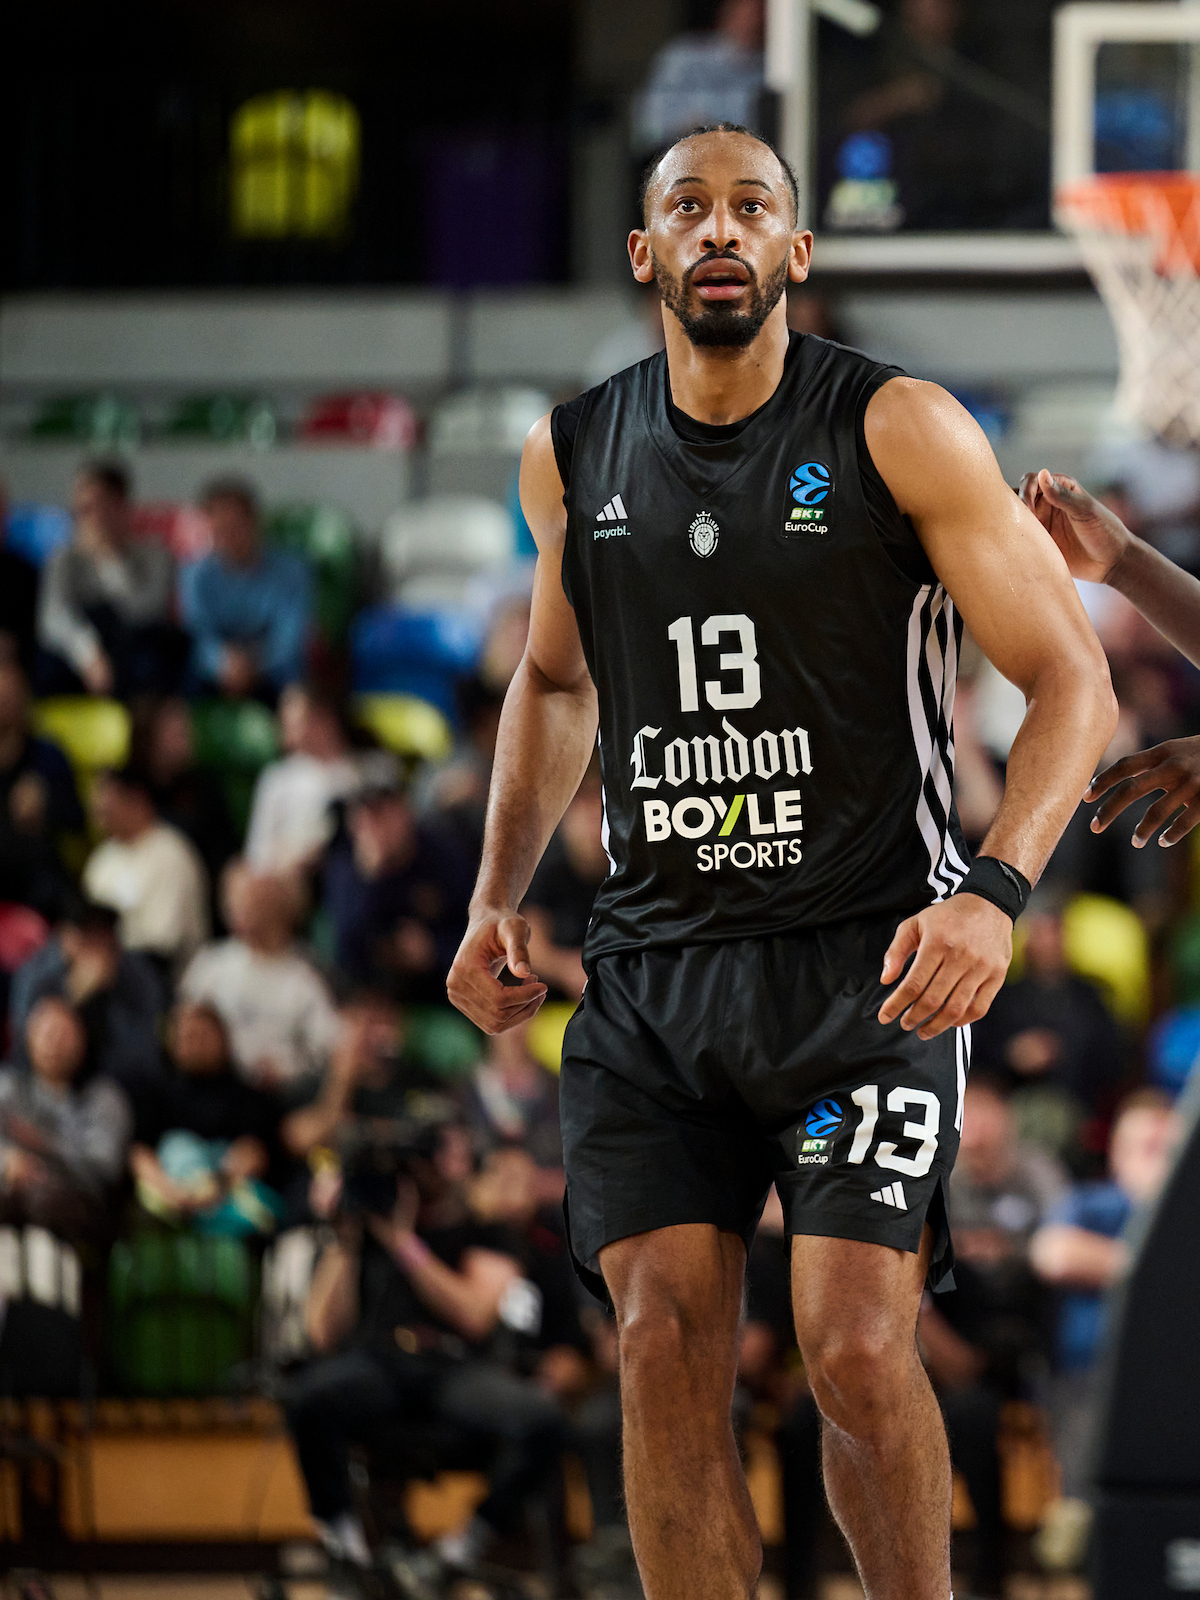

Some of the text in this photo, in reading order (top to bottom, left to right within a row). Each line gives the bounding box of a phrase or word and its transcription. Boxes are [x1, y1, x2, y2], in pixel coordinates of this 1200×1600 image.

[790, 508, 824, 520] BKT
[593, 525, 632, 541] payabl.
[785, 521, 829, 535] EuroCup
[667, 613, 762, 712] 13
[629, 716, 814, 791] London
[643, 789, 803, 842] BOYLE
[696, 838, 803, 872] SPORTS
[848, 1085, 941, 1178] 13
[802, 1139, 828, 1152] BKT
[797, 1153, 829, 1165] EuroCup
